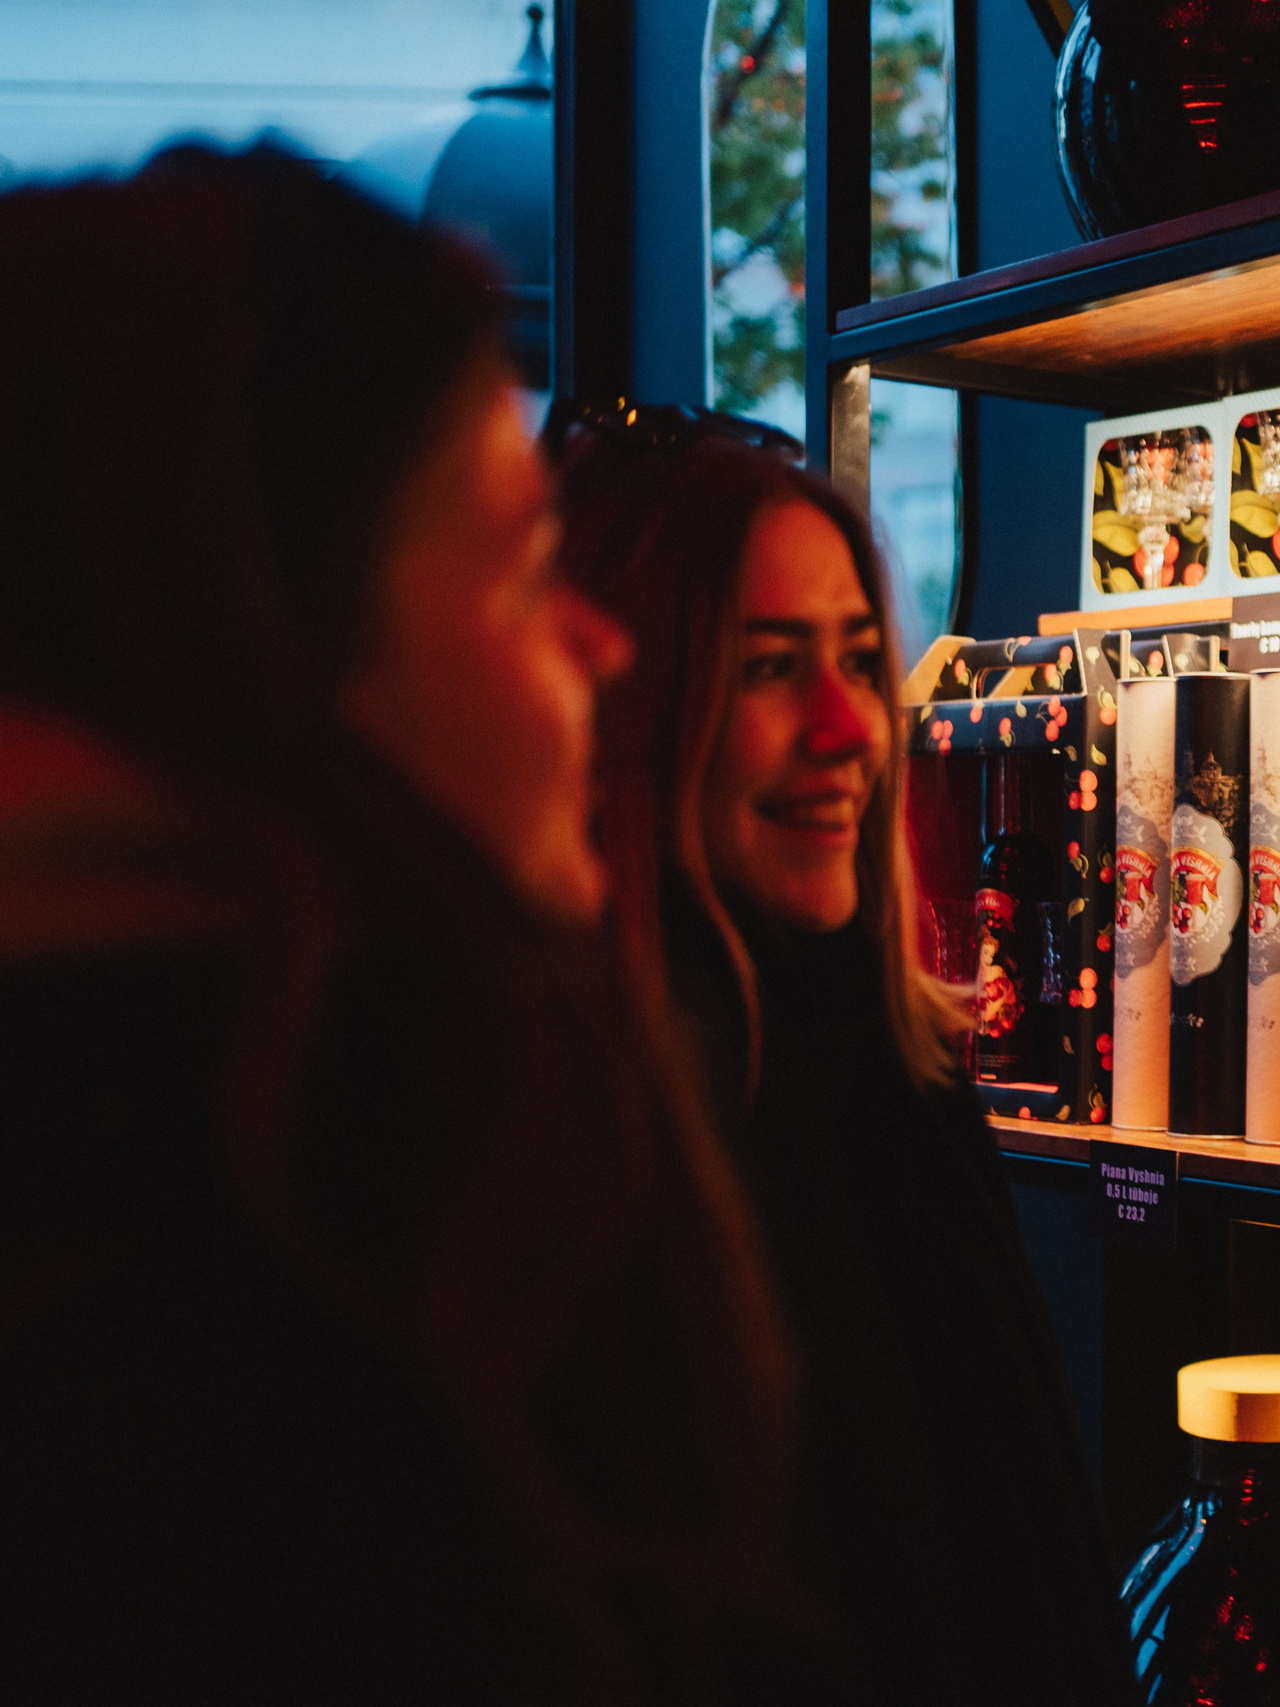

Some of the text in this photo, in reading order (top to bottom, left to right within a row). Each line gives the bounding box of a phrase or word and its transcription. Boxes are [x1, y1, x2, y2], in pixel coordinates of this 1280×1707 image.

[1101, 1162, 1165, 1186] Piana Vyshnia
[1106, 1182, 1120, 1199] 0.5
